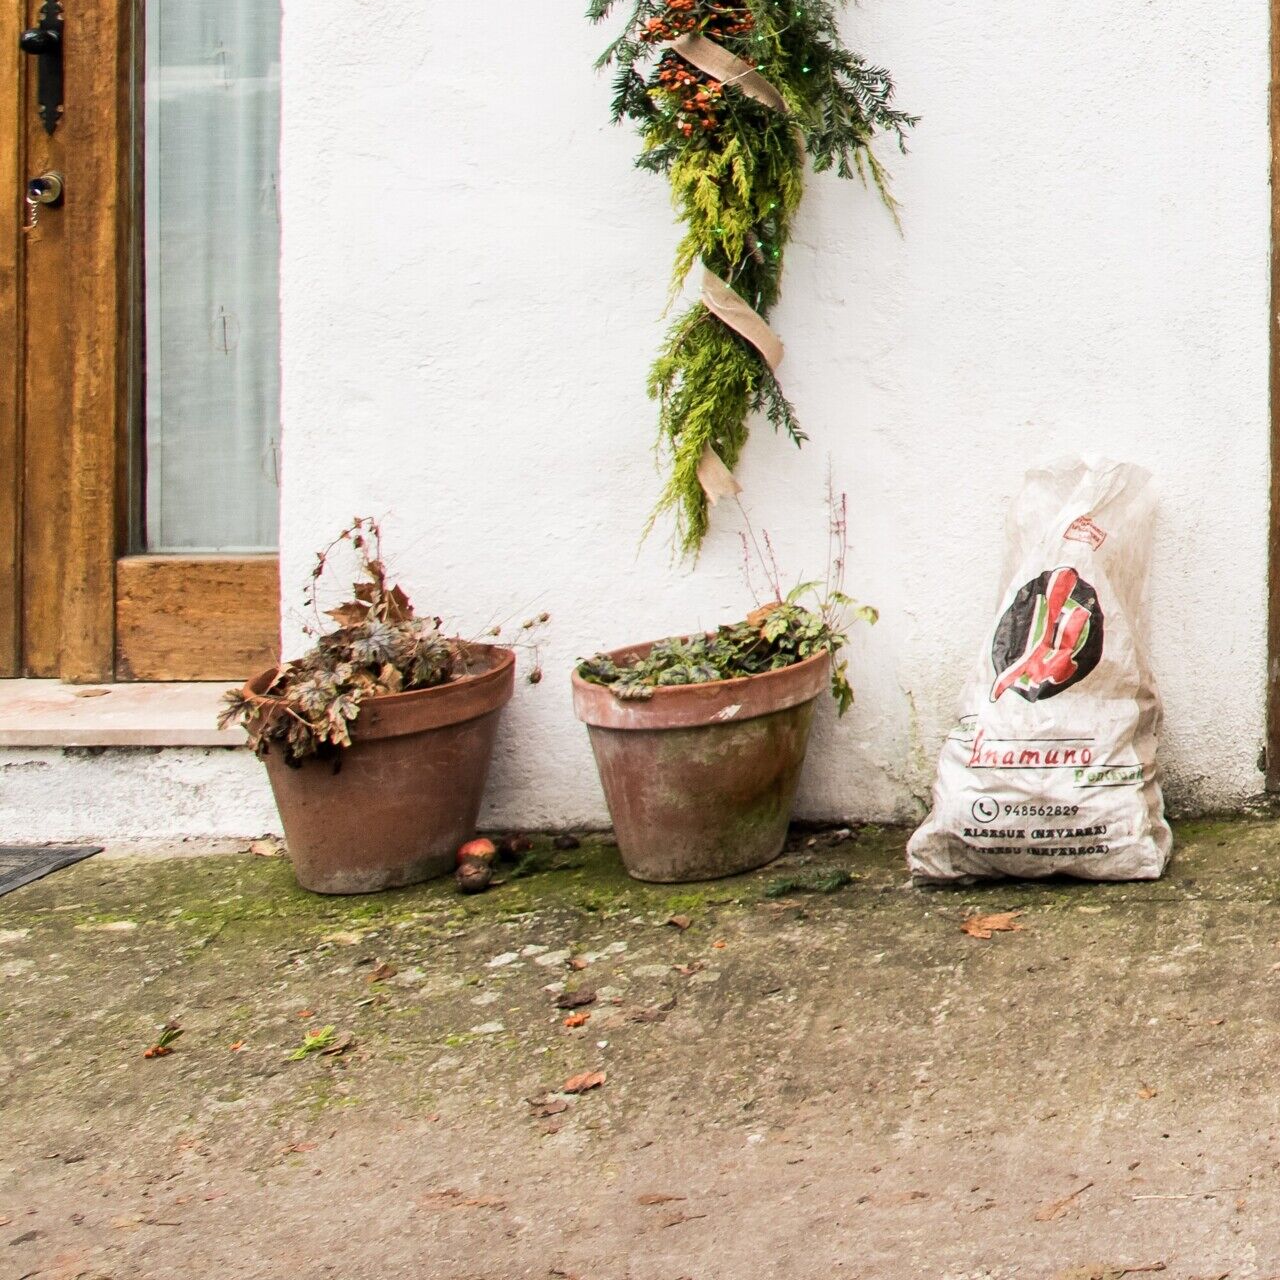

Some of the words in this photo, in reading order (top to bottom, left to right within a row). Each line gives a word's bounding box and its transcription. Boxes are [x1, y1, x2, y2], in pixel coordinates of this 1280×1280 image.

[1004, 805, 1080, 817] 948562829
[963, 827, 1026, 839] ALSASUA
[1030, 825, 1107, 840] (NAVARRA)
[1026, 844, 1110, 857] (NAFARROA)
